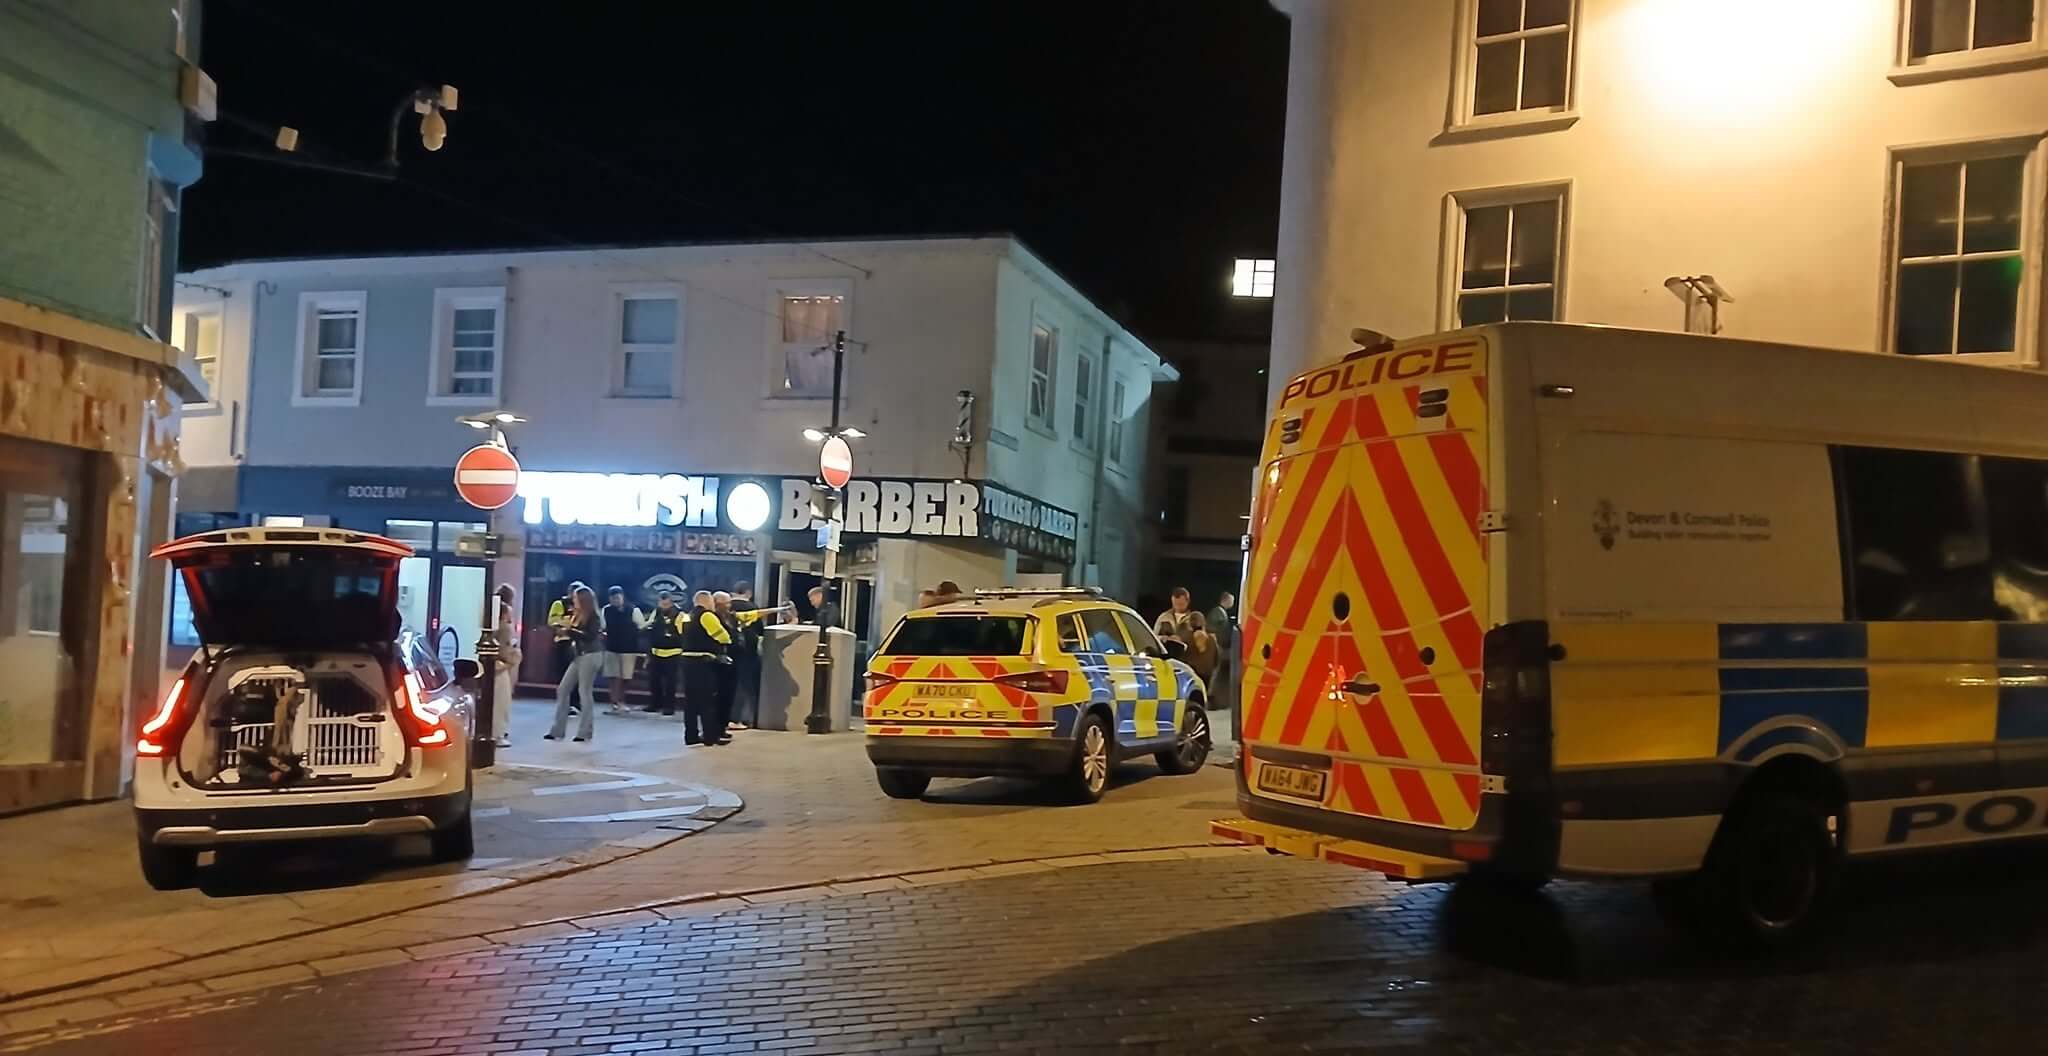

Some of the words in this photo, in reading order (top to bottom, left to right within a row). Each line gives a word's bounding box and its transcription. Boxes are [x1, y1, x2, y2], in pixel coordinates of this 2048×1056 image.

[1280, 341, 1478, 409] POLICE
[348, 486, 384, 498] BOOZE
[387, 486, 408, 498] BAY
[518, 471, 720, 528] TUISH
[1627, 511, 1665, 525] Devon
[917, 684, 945, 697] WA70
[882, 709, 1008, 719] POLICE
[1264, 767, 1292, 786] WA64
[1886, 795, 2048, 844] PO
